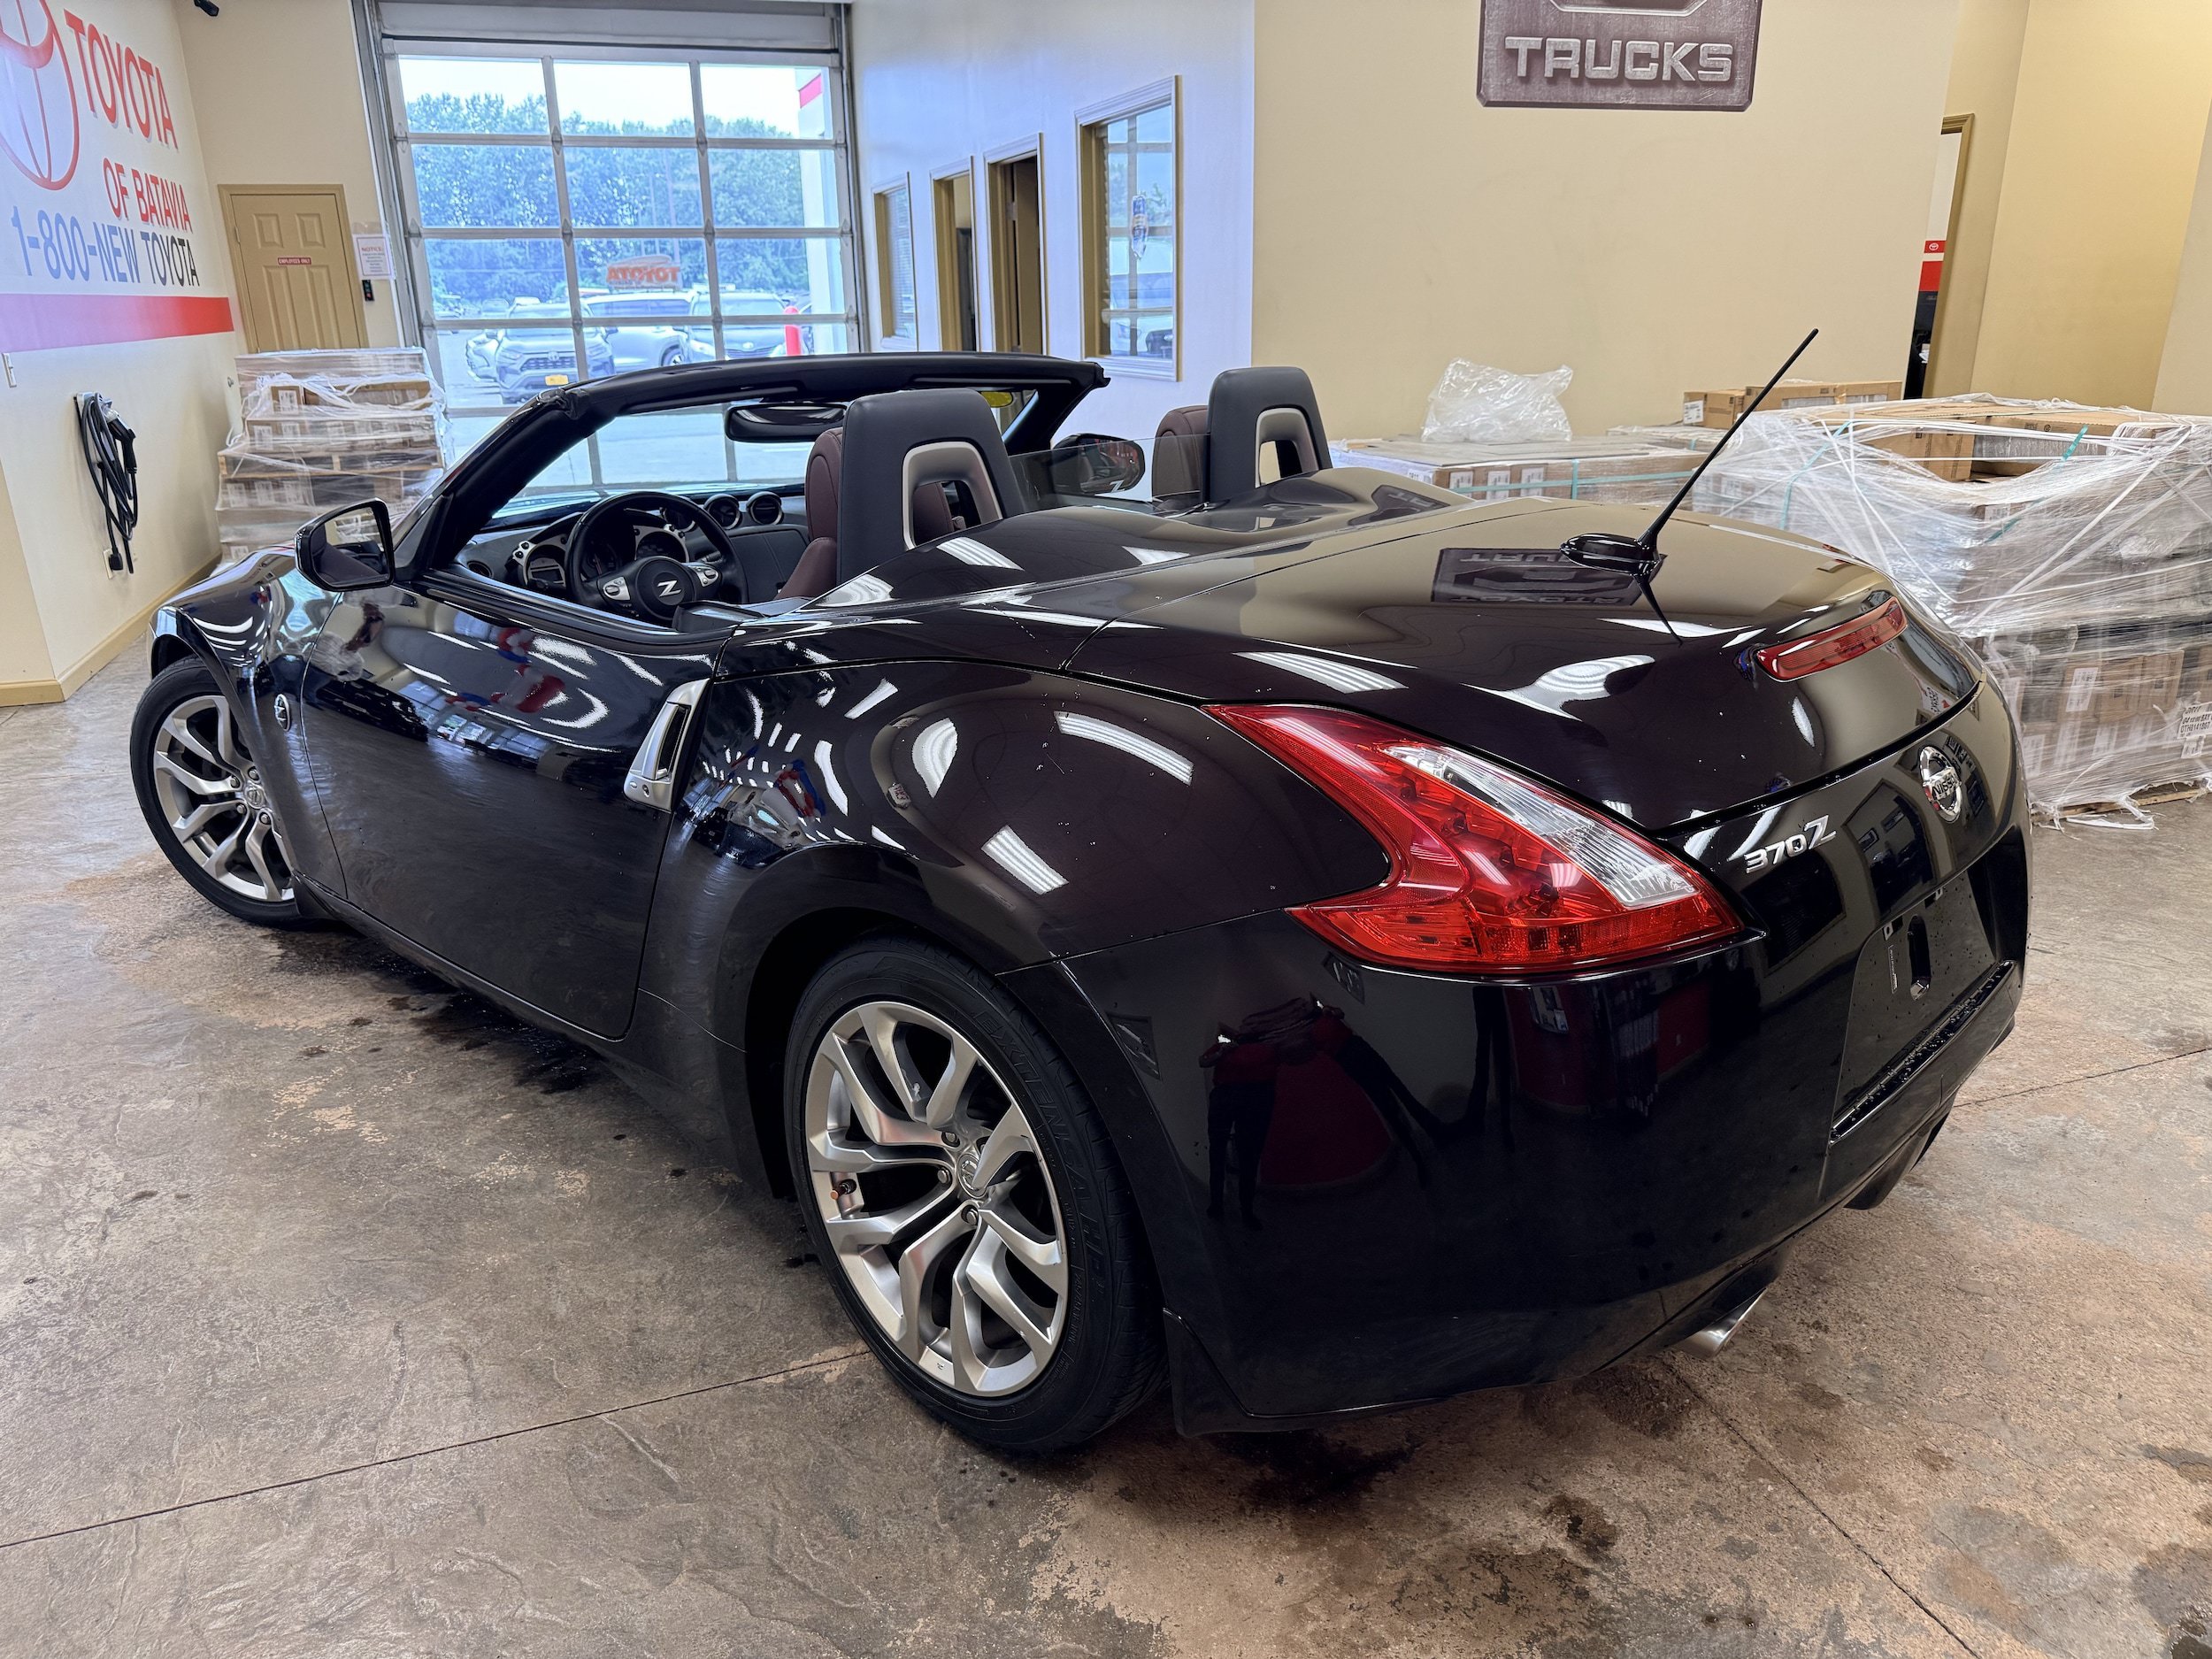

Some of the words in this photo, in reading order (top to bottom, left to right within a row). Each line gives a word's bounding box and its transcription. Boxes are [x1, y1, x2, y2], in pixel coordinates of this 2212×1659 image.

[64, 9, 178, 150] TOYOTA
[1505, 36, 1733, 82] TRUCKS
[103, 157, 129, 219] OF
[132, 168, 193, 233] BATAVIA
[11, 205, 141, 283] 1-800-NEW
[140, 231, 200, 287] TOYOTA
[657, 580, 681, 597] Z
[1744, 815, 1836, 873] 370Z
